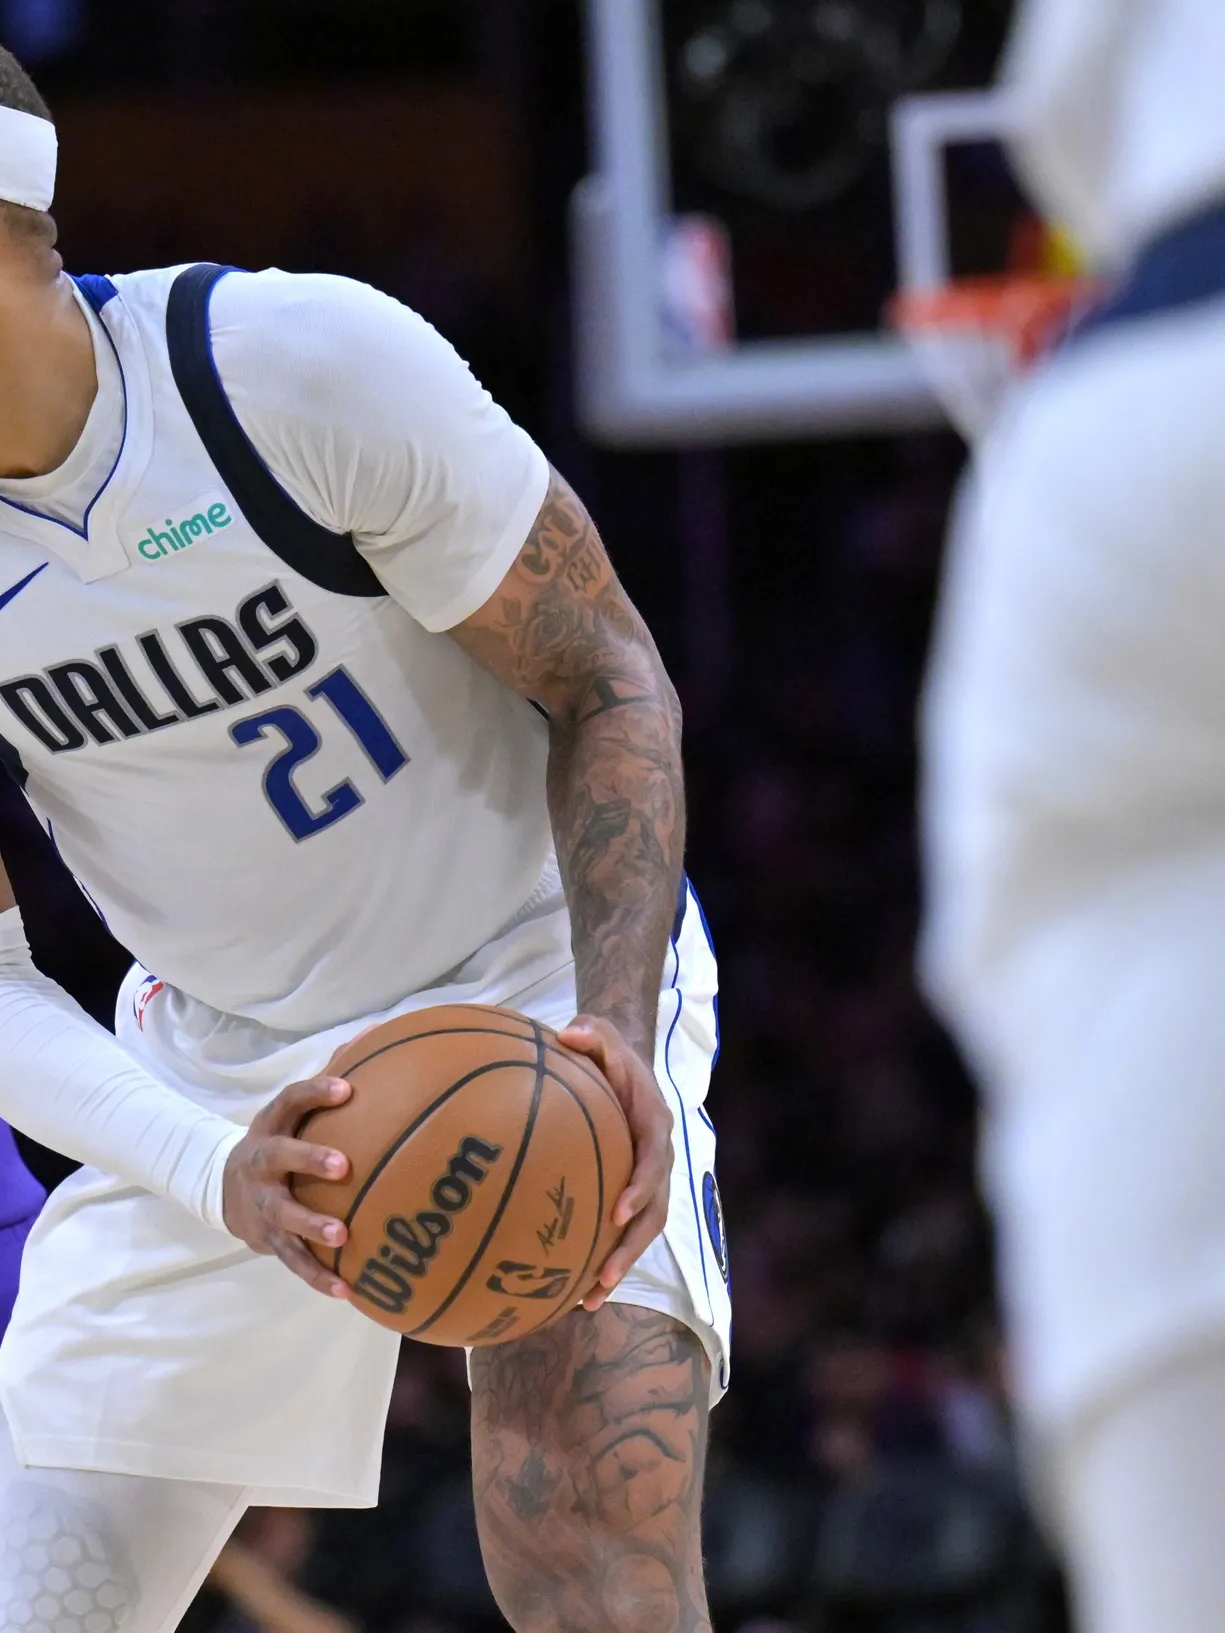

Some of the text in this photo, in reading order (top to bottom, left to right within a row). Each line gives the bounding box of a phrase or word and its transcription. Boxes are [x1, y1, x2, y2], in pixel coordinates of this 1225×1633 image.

[137, 502, 232, 560] chime
[228, 664, 411, 844] 21
[352, 1134, 502, 1315] Wilson
